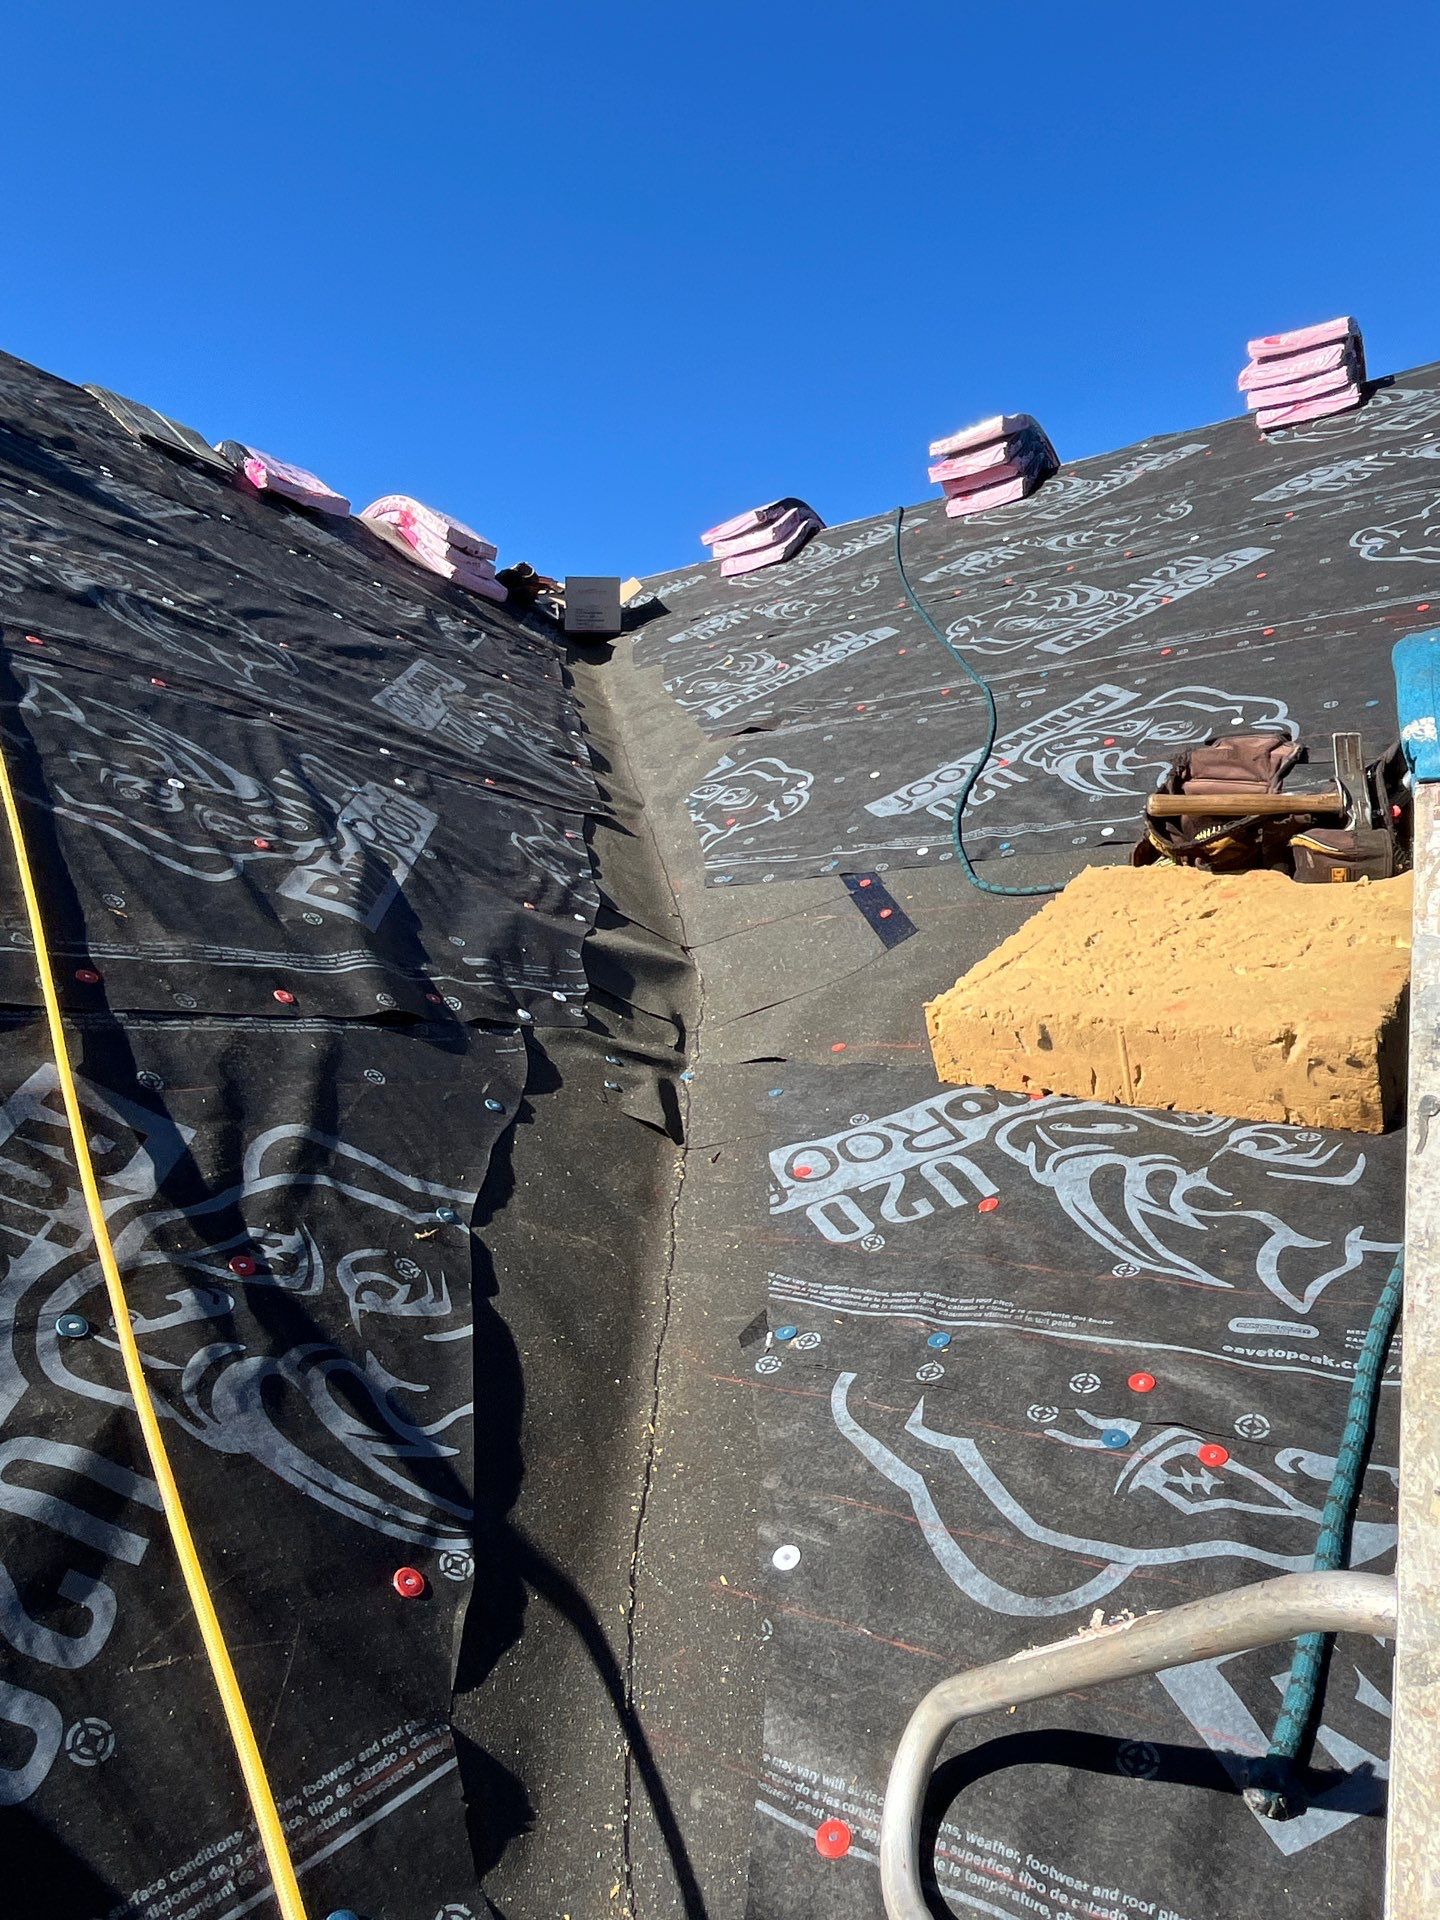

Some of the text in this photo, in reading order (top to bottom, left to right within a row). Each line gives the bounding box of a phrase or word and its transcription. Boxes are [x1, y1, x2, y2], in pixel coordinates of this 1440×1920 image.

[805, 1154, 1001, 1243] U20
[966, 1827, 1021, 1864] weather,
[1091, 1884, 1121, 1902] and
[1121, 1894, 1157, 1916] roof
